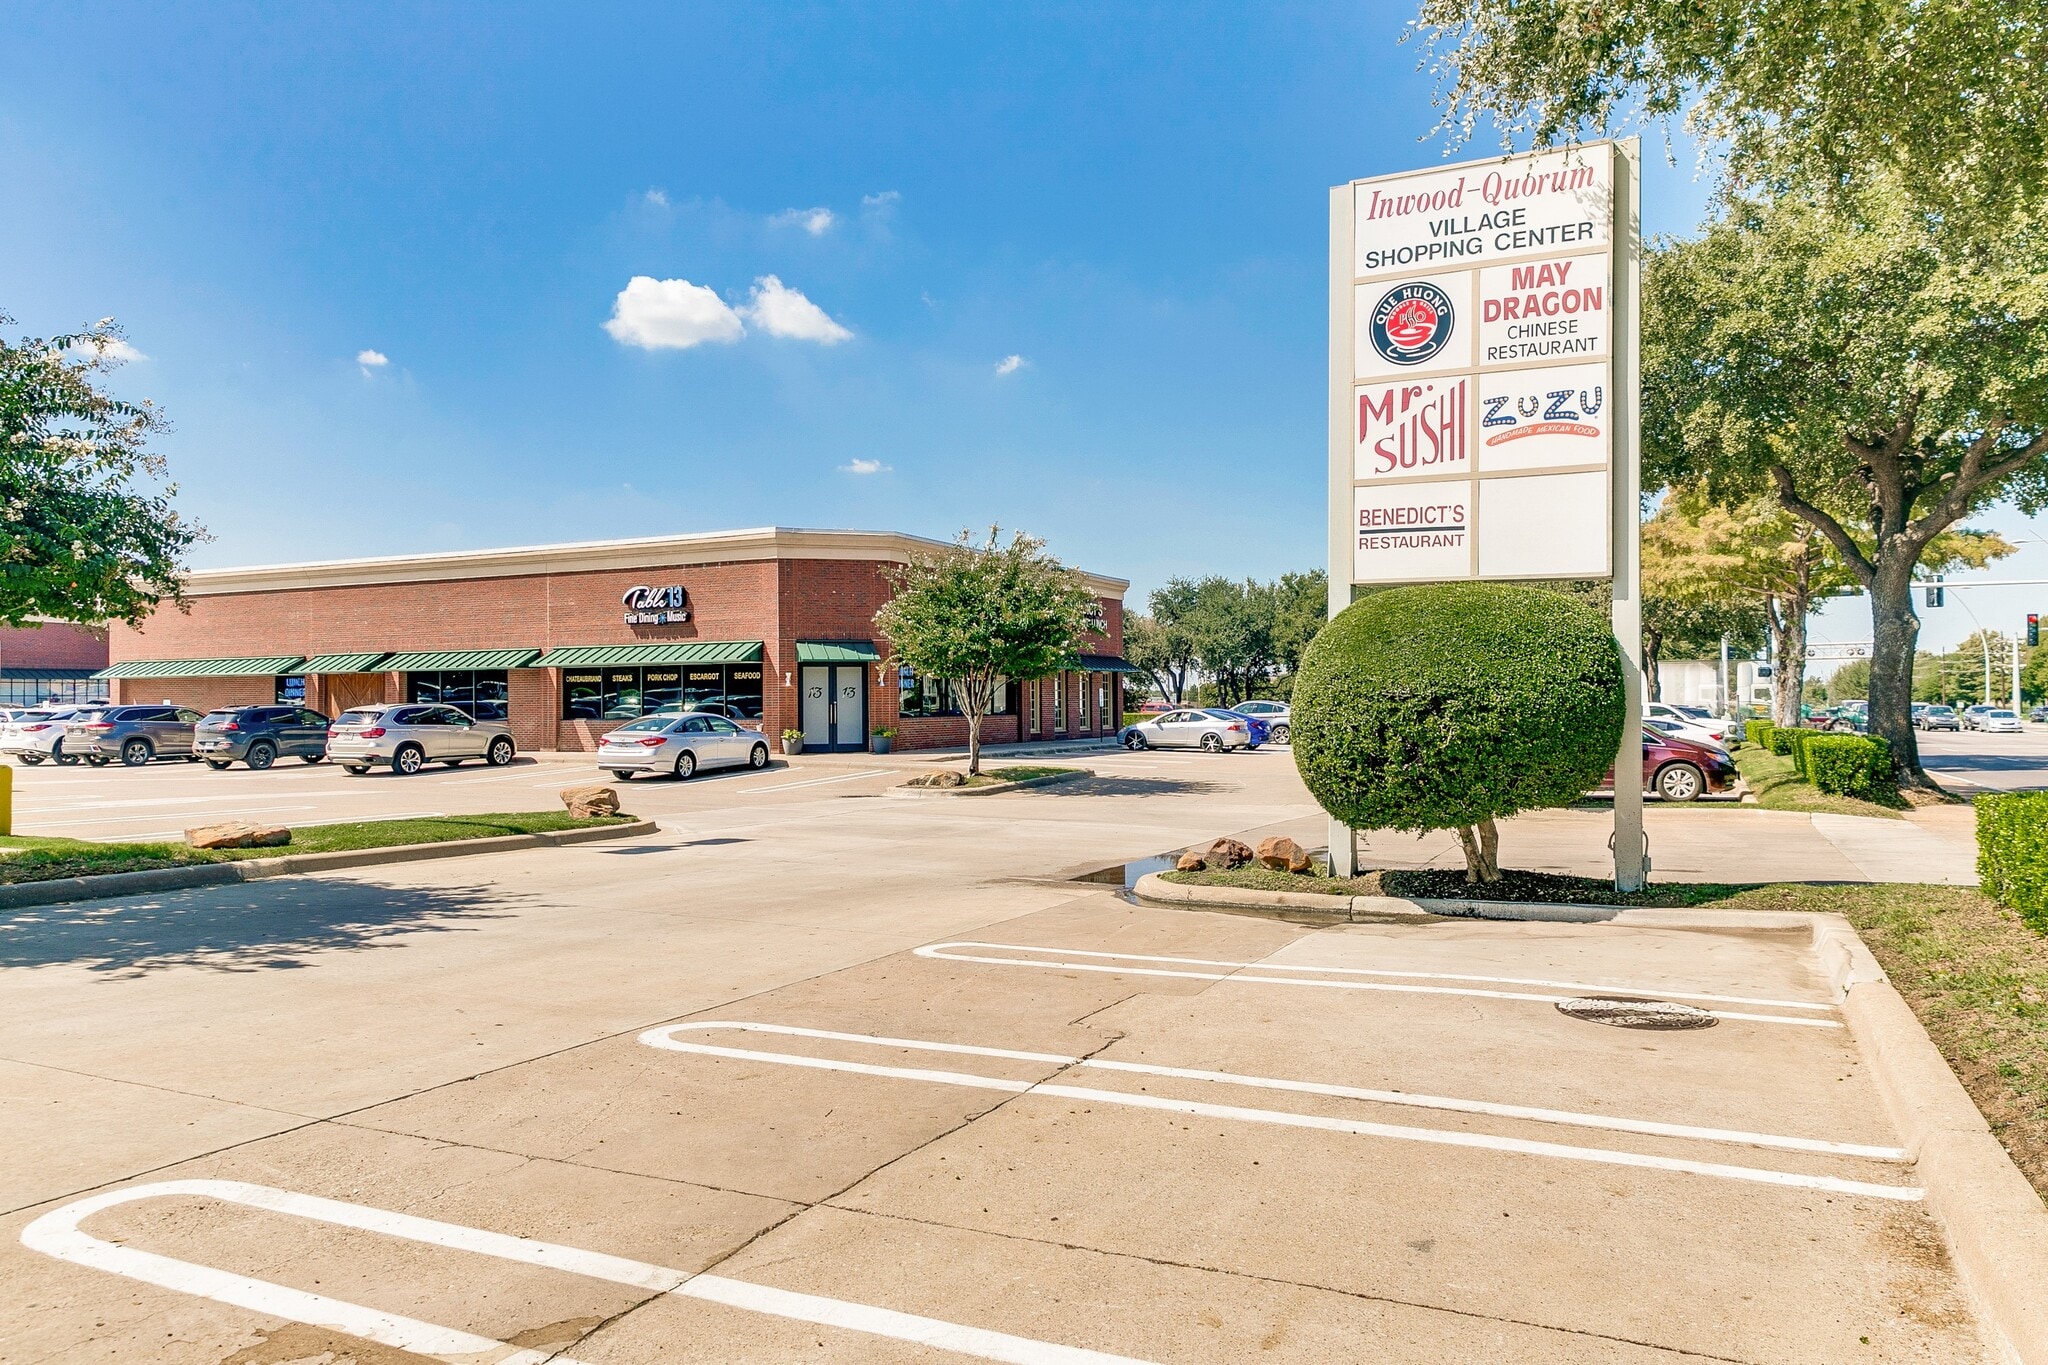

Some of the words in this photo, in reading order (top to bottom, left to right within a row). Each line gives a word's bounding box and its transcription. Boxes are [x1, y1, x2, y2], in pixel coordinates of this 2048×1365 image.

[1366, 166, 1594, 220] Inwood-Quorum
[1429, 208, 1526, 238] VILLAGE
[1366, 237, 1482, 269] SHOPPING
[1495, 222, 1593, 250] CENTER
[1512, 261, 1572, 291] MAY
[1376, 296, 1397, 325] QUE
[1402, 287, 1448, 316] HUONG
[1484, 287, 1602, 323] DRAGON
[1508, 319, 1578, 339] CHINESE
[1488, 337, 1598, 360] RESTAURANT
[1360, 385, 1433, 444] Mr.
[1375, 379, 1465, 474] SUSHI
[1491, 427, 1533, 445] HANDMADE
[1536, 425, 1572, 434] MEXICAN
[1574, 425, 1597, 435] FOOD
[1360, 505, 1464, 527] BENEDICT'S
[1359, 534, 1465, 550] RESTAURANT
[622, 585, 667, 609] Table
[667, 585, 683, 607] 13
[624, 612, 638, 624] Fine
[639, 612, 659, 625] Dining
[667, 611, 687, 622] Music
[612, 674, 633, 682] STEAKS
[662, 673, 678, 681] CHOP
[285, 688, 305, 697] DINNE
[808, 686, 822, 699] 13
[842, 686, 856, 699] 13
